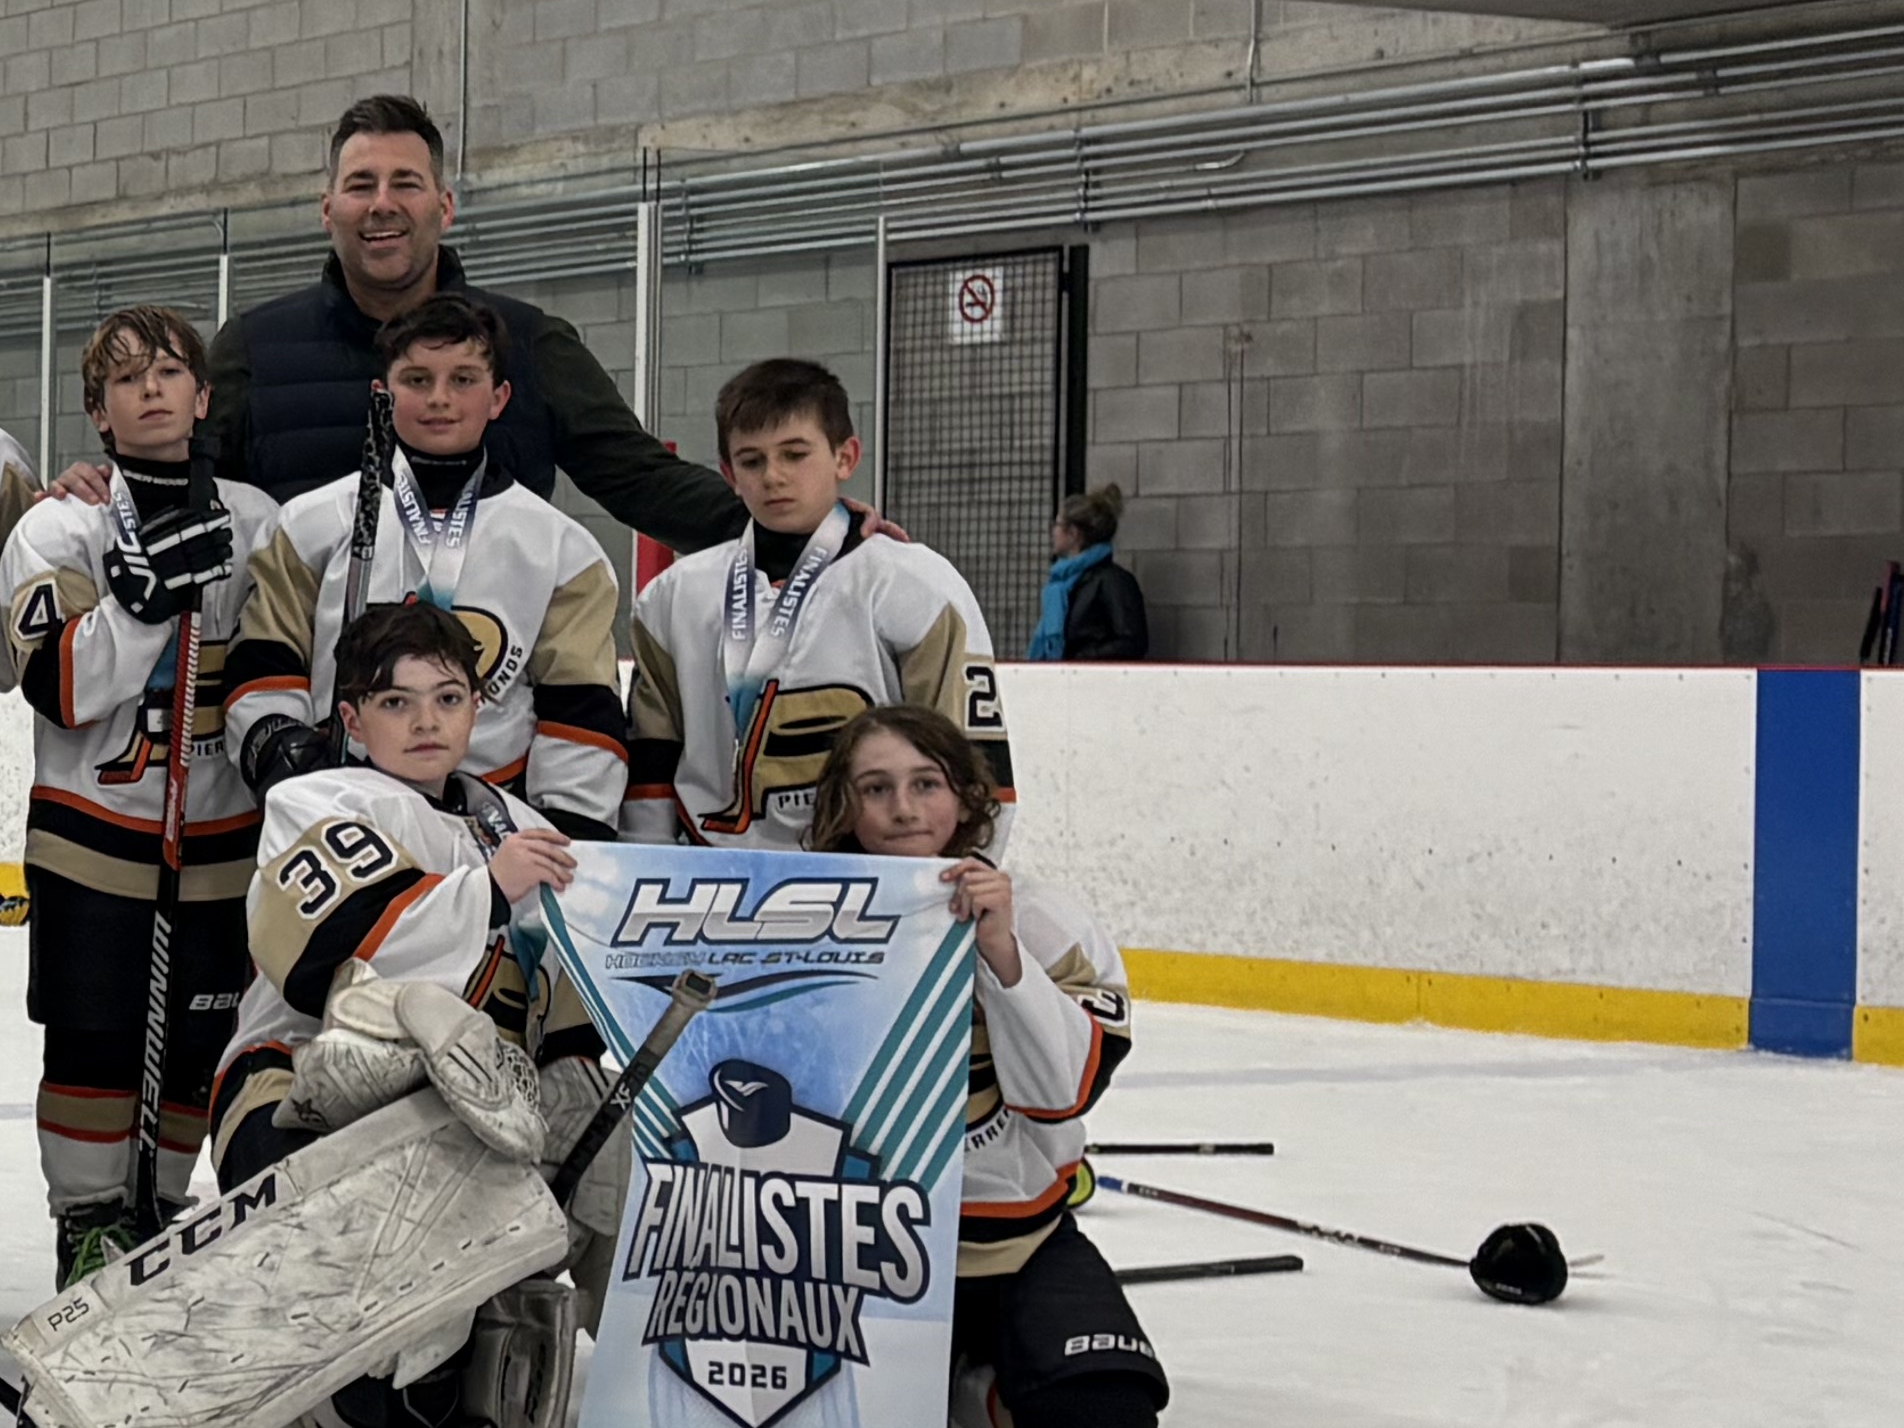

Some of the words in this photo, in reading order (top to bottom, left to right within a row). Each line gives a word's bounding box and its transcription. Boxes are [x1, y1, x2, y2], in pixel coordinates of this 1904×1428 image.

[15, 578, 65, 642] 4
[772, 546, 828, 637] FINALISTES
[965, 665, 1005, 732] 2
[278, 816, 399, 921] 39
[609, 877, 900, 946] HLSL
[707, 951, 755, 966] LAC
[759, 950, 885, 967] ST-LOUIS
[123, 1172, 278, 1287] CCM
[626, 1160, 932, 1303] FINALISTES
[47, 1297, 90, 1332] P25
[707, 1360, 789, 1389] 2026
